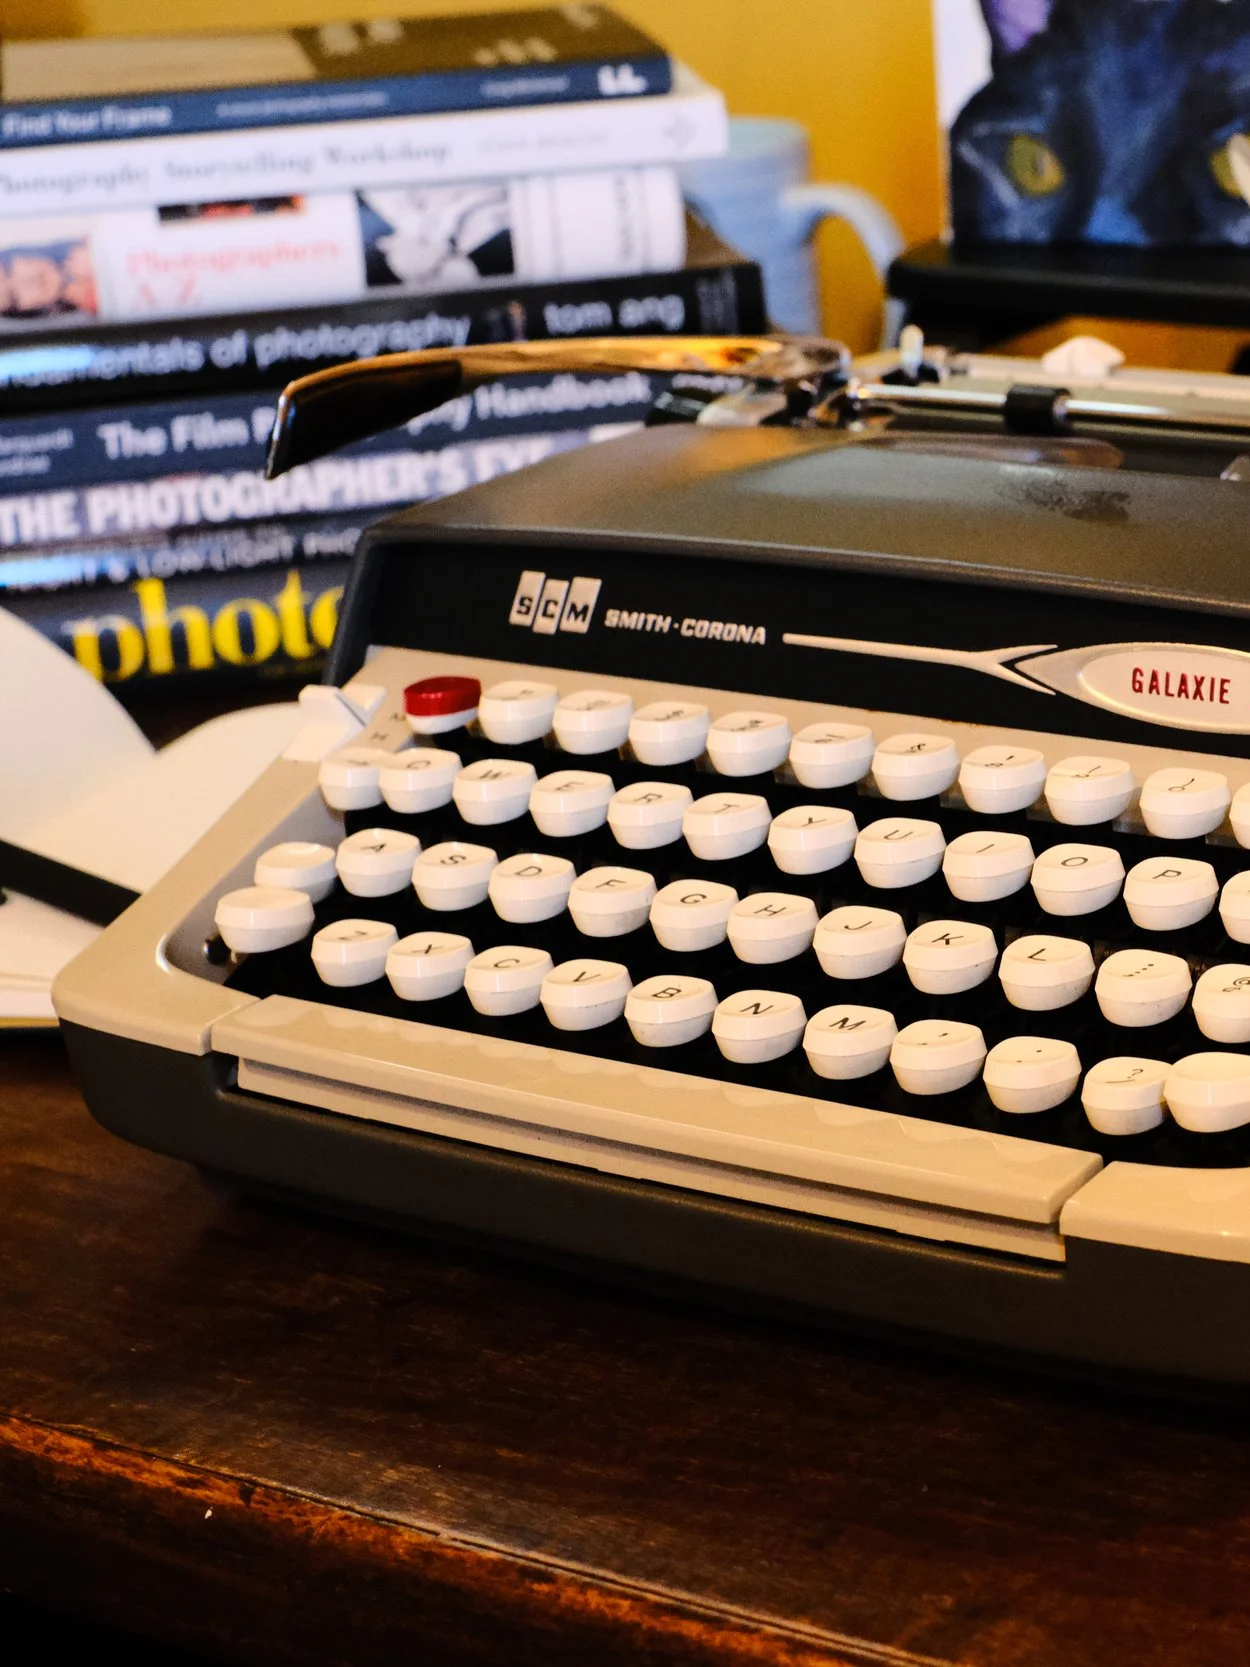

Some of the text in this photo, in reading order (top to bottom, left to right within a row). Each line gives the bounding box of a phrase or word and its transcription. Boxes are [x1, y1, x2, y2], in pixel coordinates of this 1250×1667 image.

[544, 301, 612, 335] tom
[210, 327, 248, 369] of
[474, 371, 651, 420] Handbook
[97, 419, 167, 460] The
[170, 411, 250, 452] Film
[0, 490, 80, 543] THE
[1132, 666, 1232, 705] GALAXIE
[883, 829, 914, 842] U
[440, 854, 467, 866] S
[1060, 856, 1089, 868] O
[515, 865, 543, 878] D
[1152, 869, 1182, 880] P
[595, 878, 627, 889] F
[679, 893, 708, 905] G
[753, 904, 787, 917] H
[843, 920, 873, 931] J
[931, 932, 965, 946] K
[1027, 947, 1047, 962] L
[493, 957, 520, 969] C
[573, 970, 602, 983] V
[651, 986, 682, 999] B
[739, 1002, 775, 1015] N
[828, 1016, 867, 1031] M
